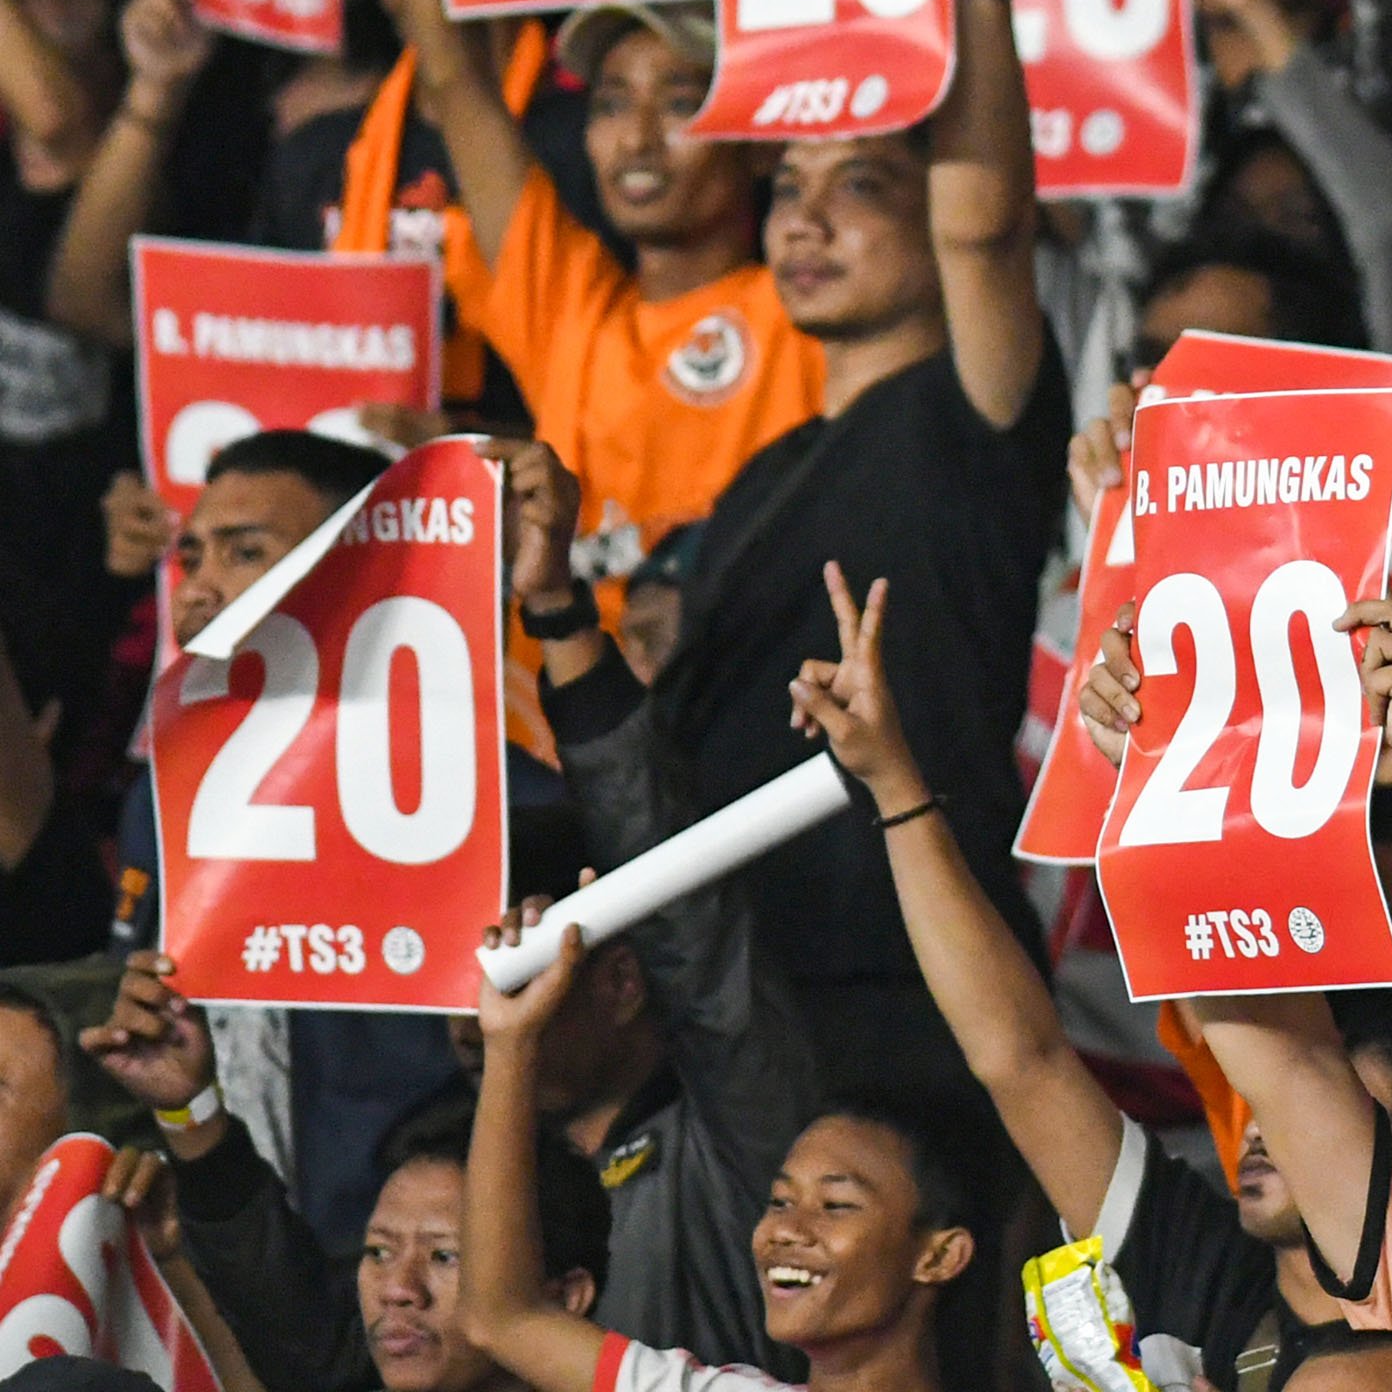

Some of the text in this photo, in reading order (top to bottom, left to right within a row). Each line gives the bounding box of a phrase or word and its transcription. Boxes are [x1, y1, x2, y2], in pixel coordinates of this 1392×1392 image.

[1135, 454, 1375, 516] B. PAMUNGKAS
[180, 595, 478, 867] 20
[1118, 559, 1363, 848] 20
[241, 925, 365, 975] #TS3
[1184, 907, 1281, 960] #TS3
